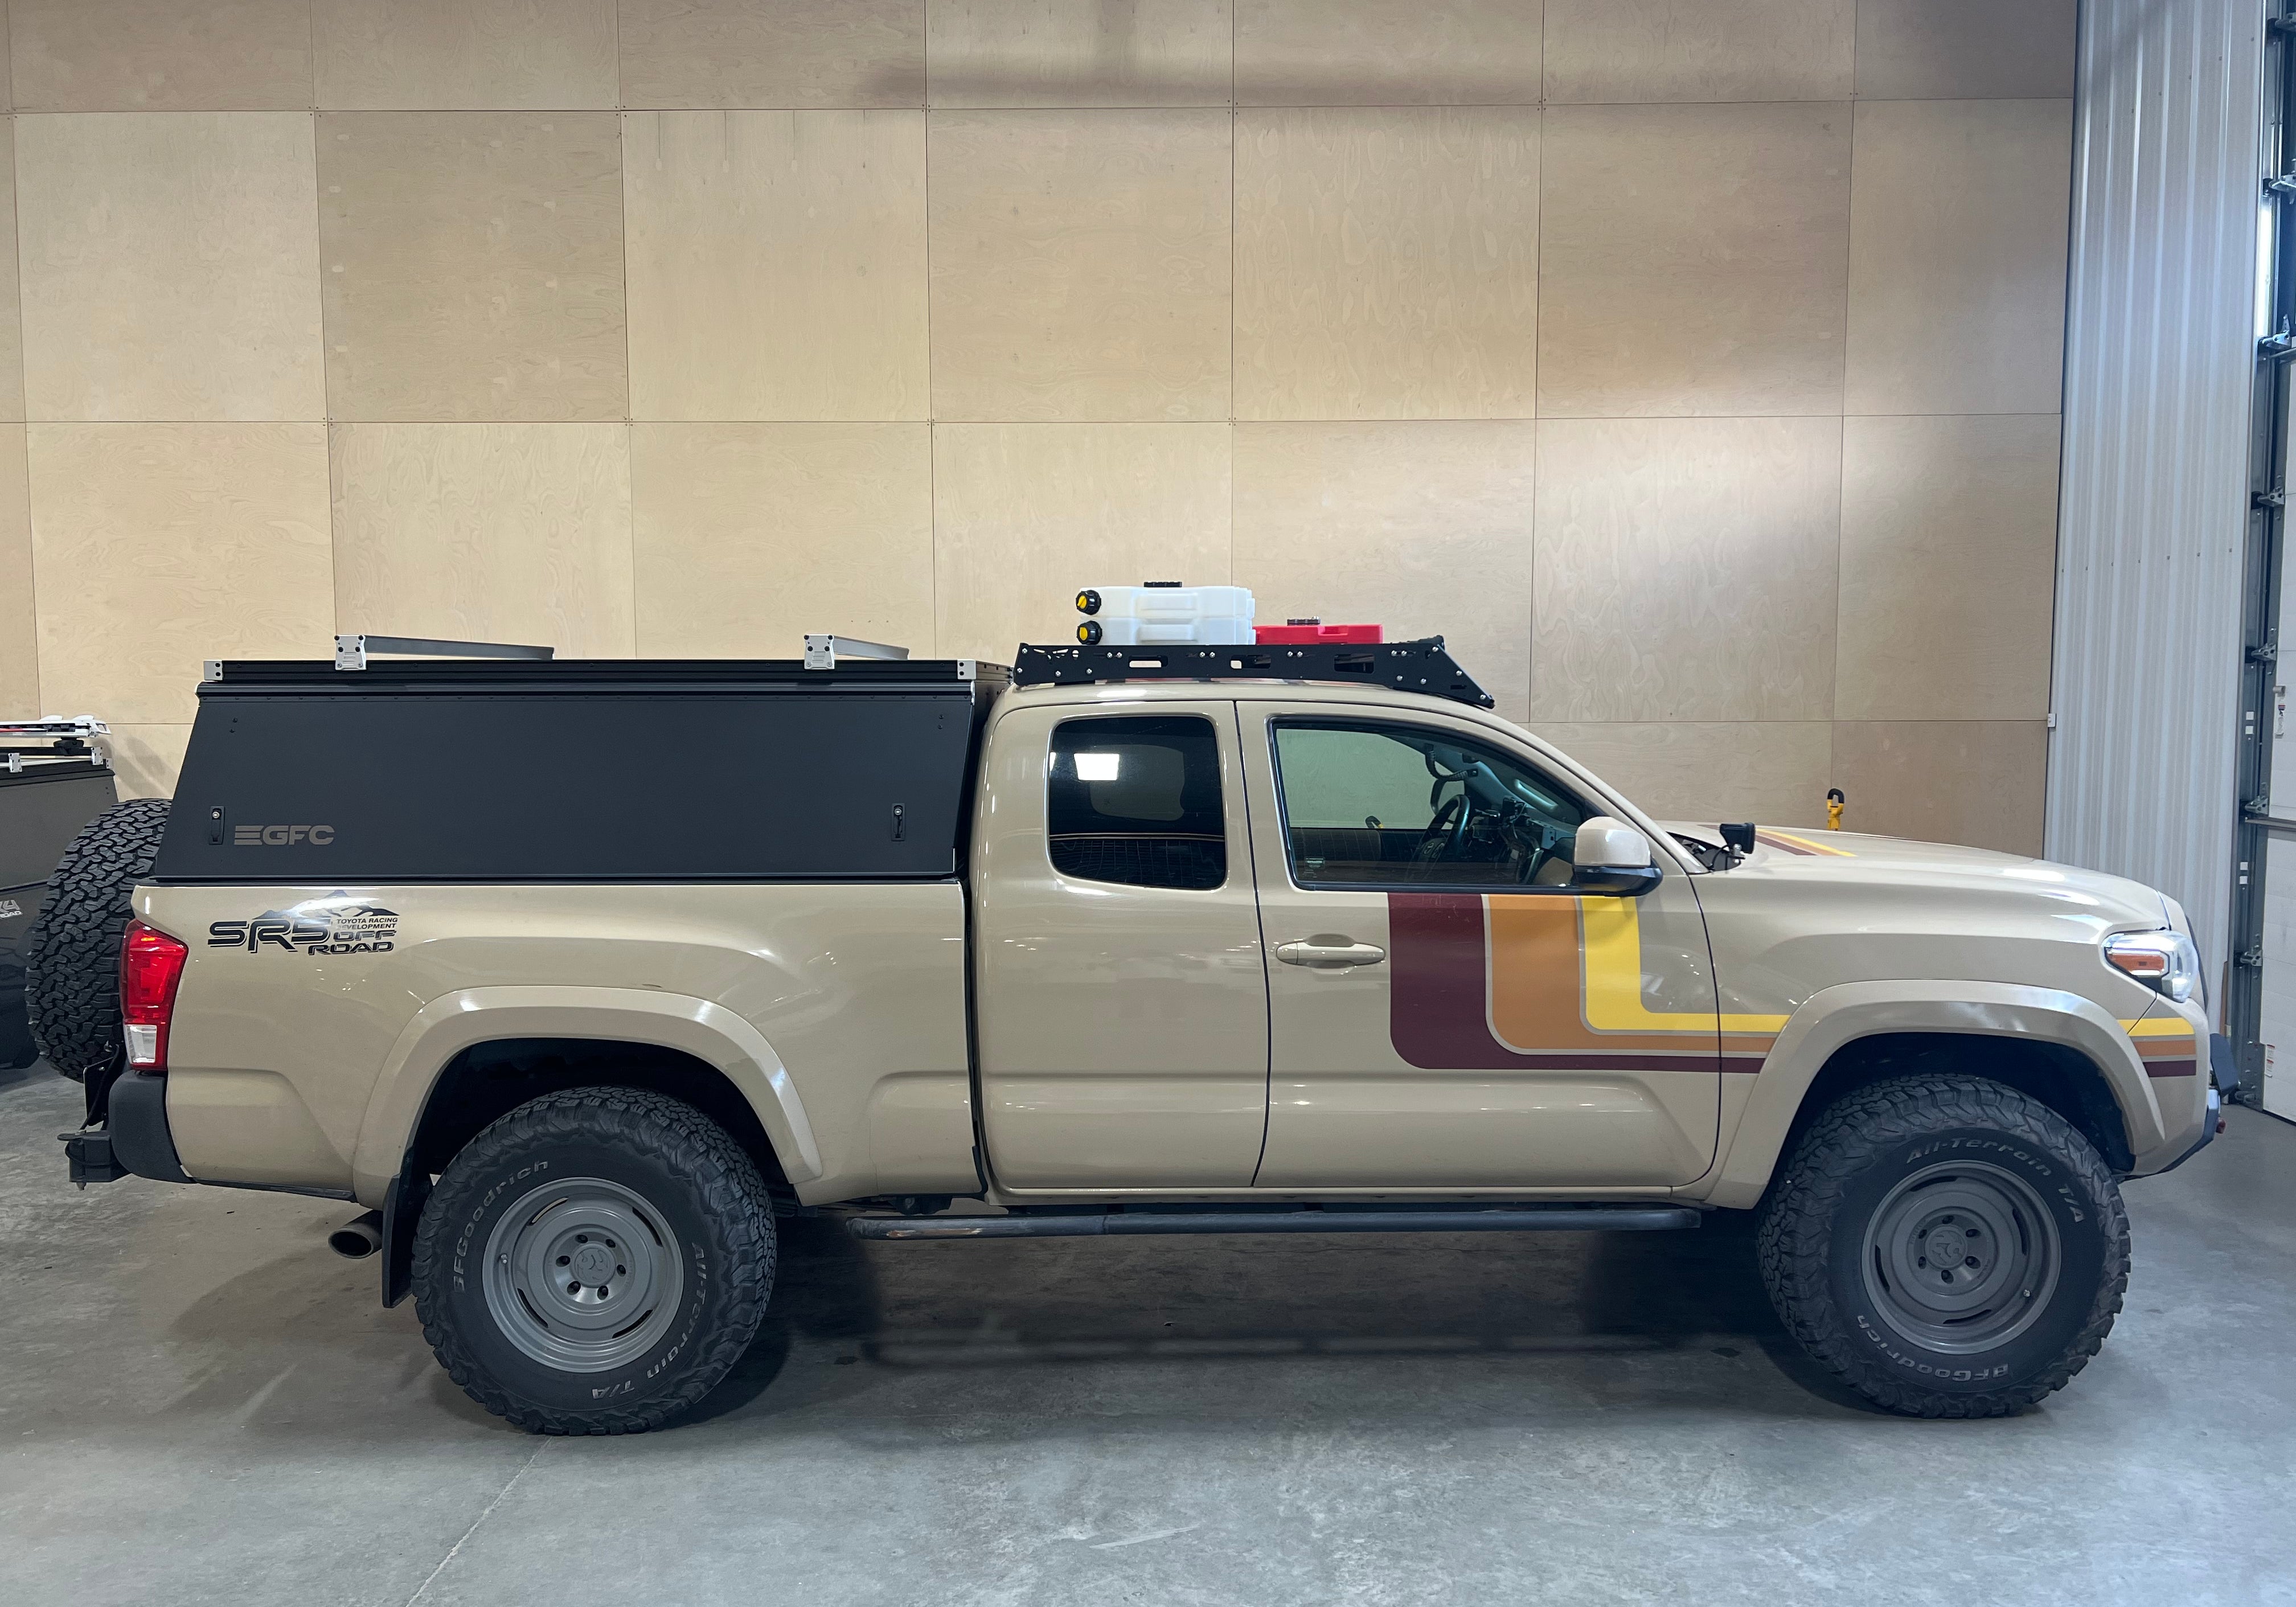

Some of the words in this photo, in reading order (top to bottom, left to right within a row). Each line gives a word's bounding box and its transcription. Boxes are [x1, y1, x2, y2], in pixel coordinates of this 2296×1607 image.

[333, 930, 396, 941] OFF
[308, 941, 394, 956] ROAD
[2058, 1184, 2085, 1222] T/A
[1857, 1315, 2009, 1381] BFGoodrich
[592, 1380, 635, 1399] T/A
